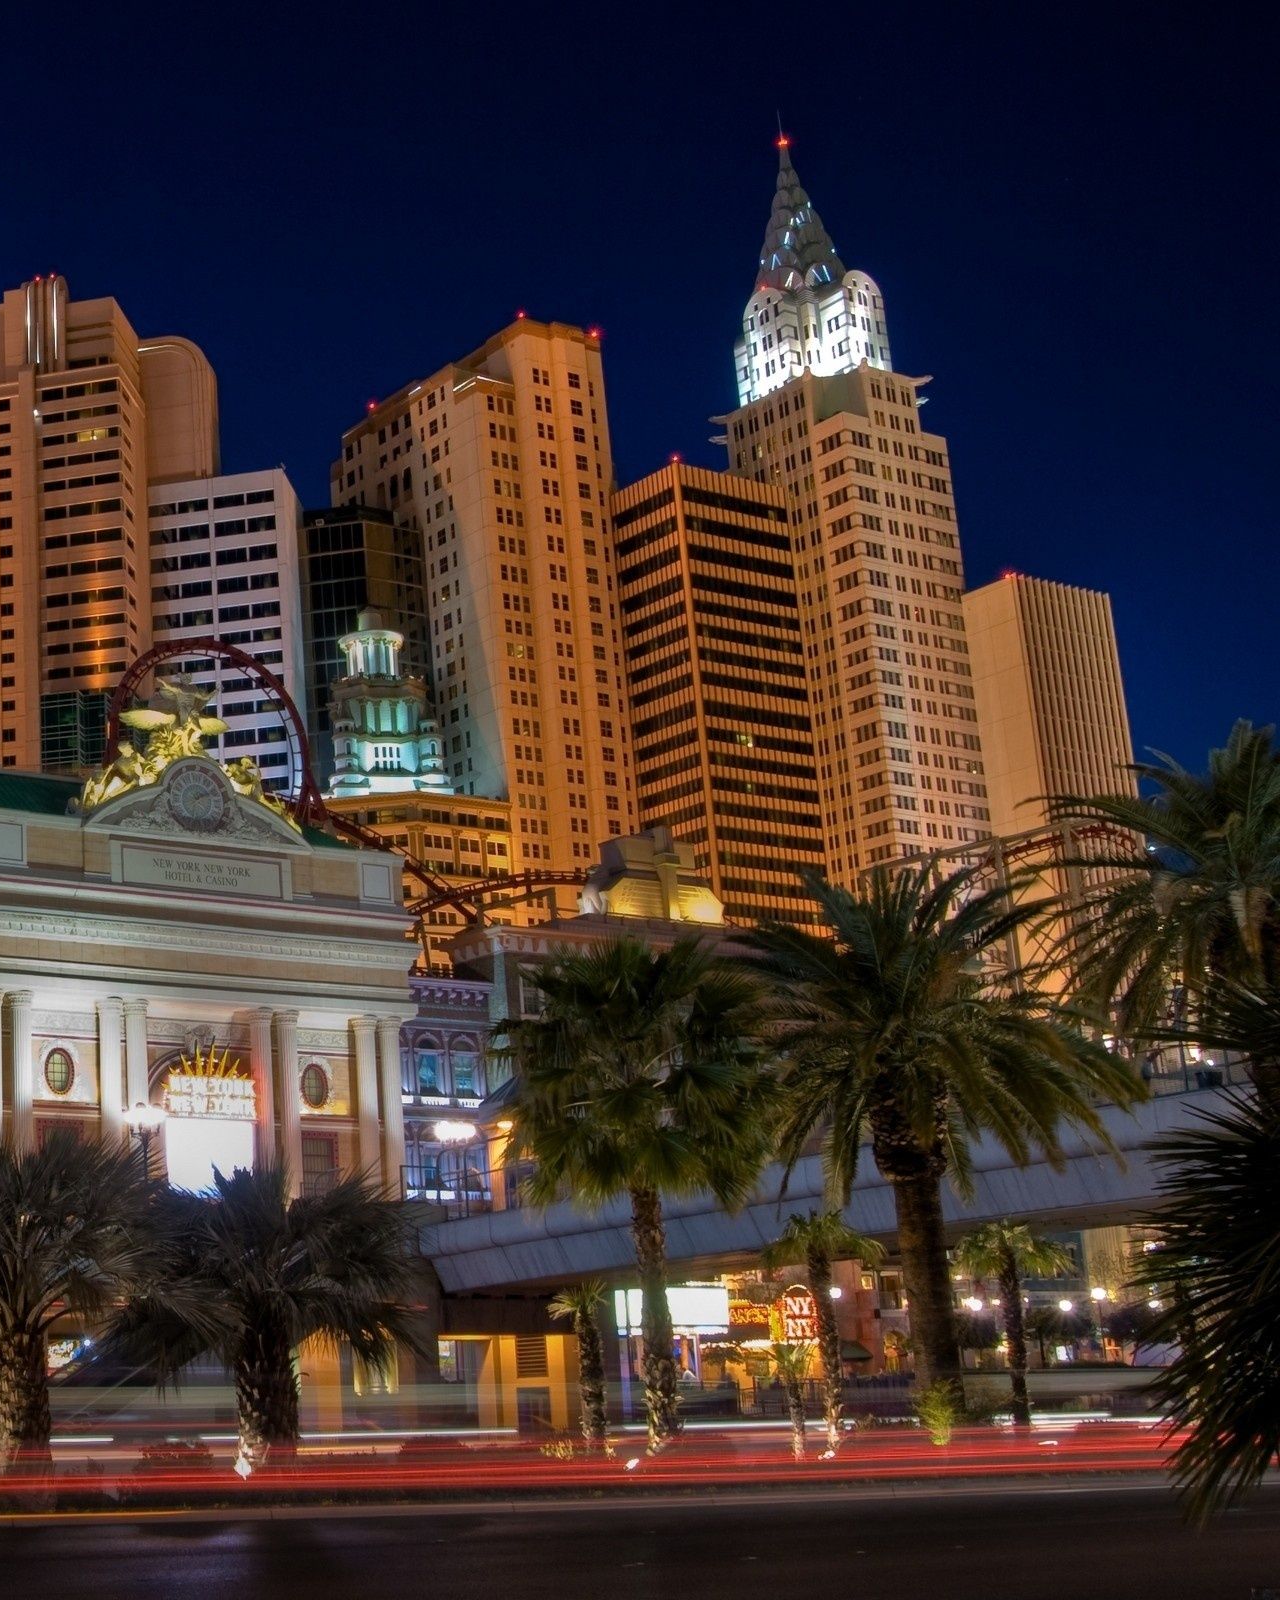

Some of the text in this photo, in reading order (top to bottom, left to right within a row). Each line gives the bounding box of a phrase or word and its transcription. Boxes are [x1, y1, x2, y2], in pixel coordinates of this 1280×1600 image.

[153, 858, 251, 877] NEW YORK NEW YORK
[165, 870, 238, 888] HOTEL & CASINO
[785, 1296, 812, 1316] NY
[786, 1318, 813, 1338] NY
